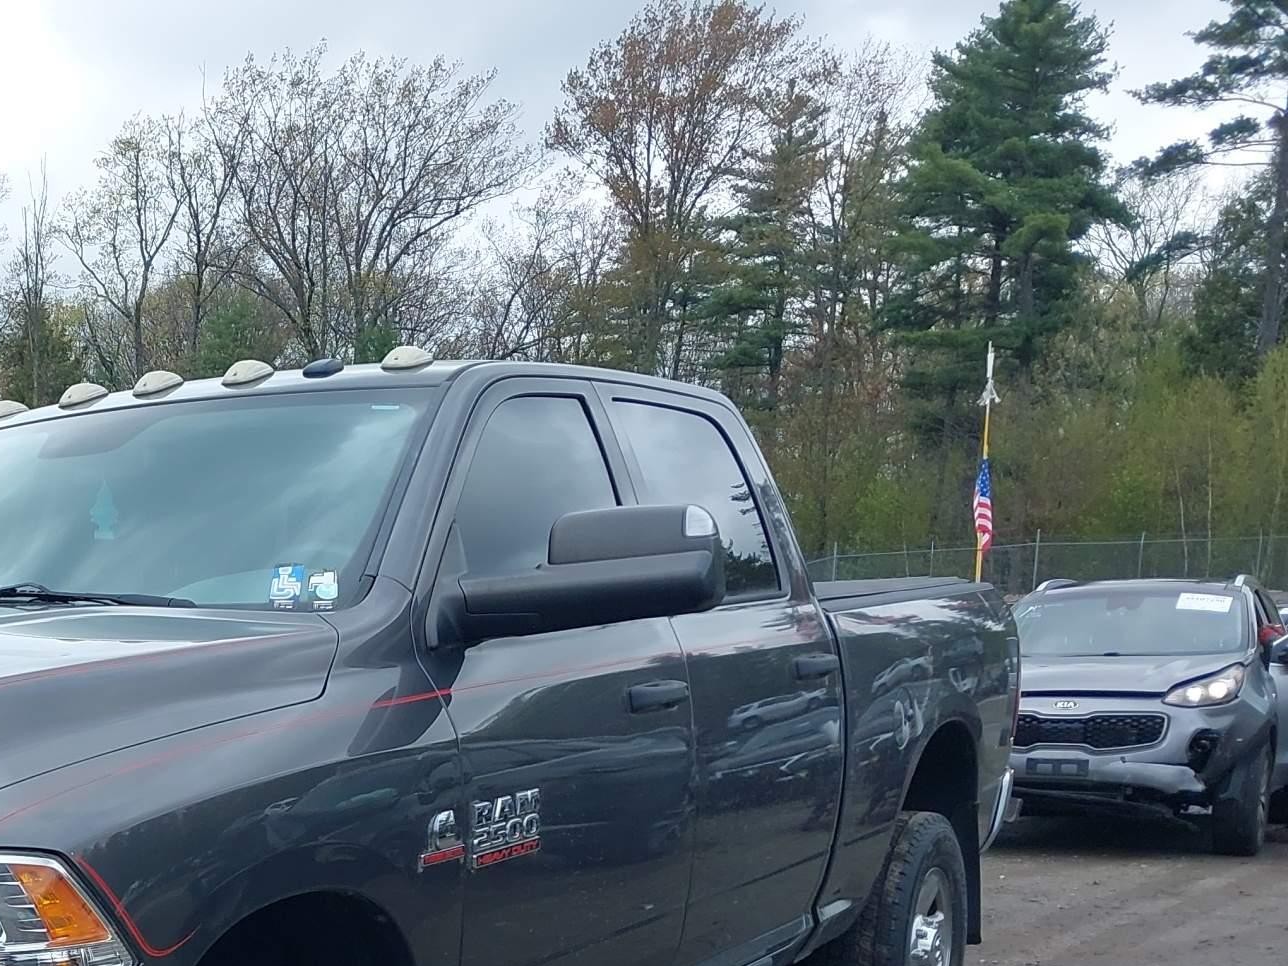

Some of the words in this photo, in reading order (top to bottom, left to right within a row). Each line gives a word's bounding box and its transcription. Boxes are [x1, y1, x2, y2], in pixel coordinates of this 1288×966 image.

[472, 788, 540, 826] RAM
[473, 813, 540, 848] 2500
[477, 847, 511, 866] HEAVY
[511, 840, 539, 856] DUTY
